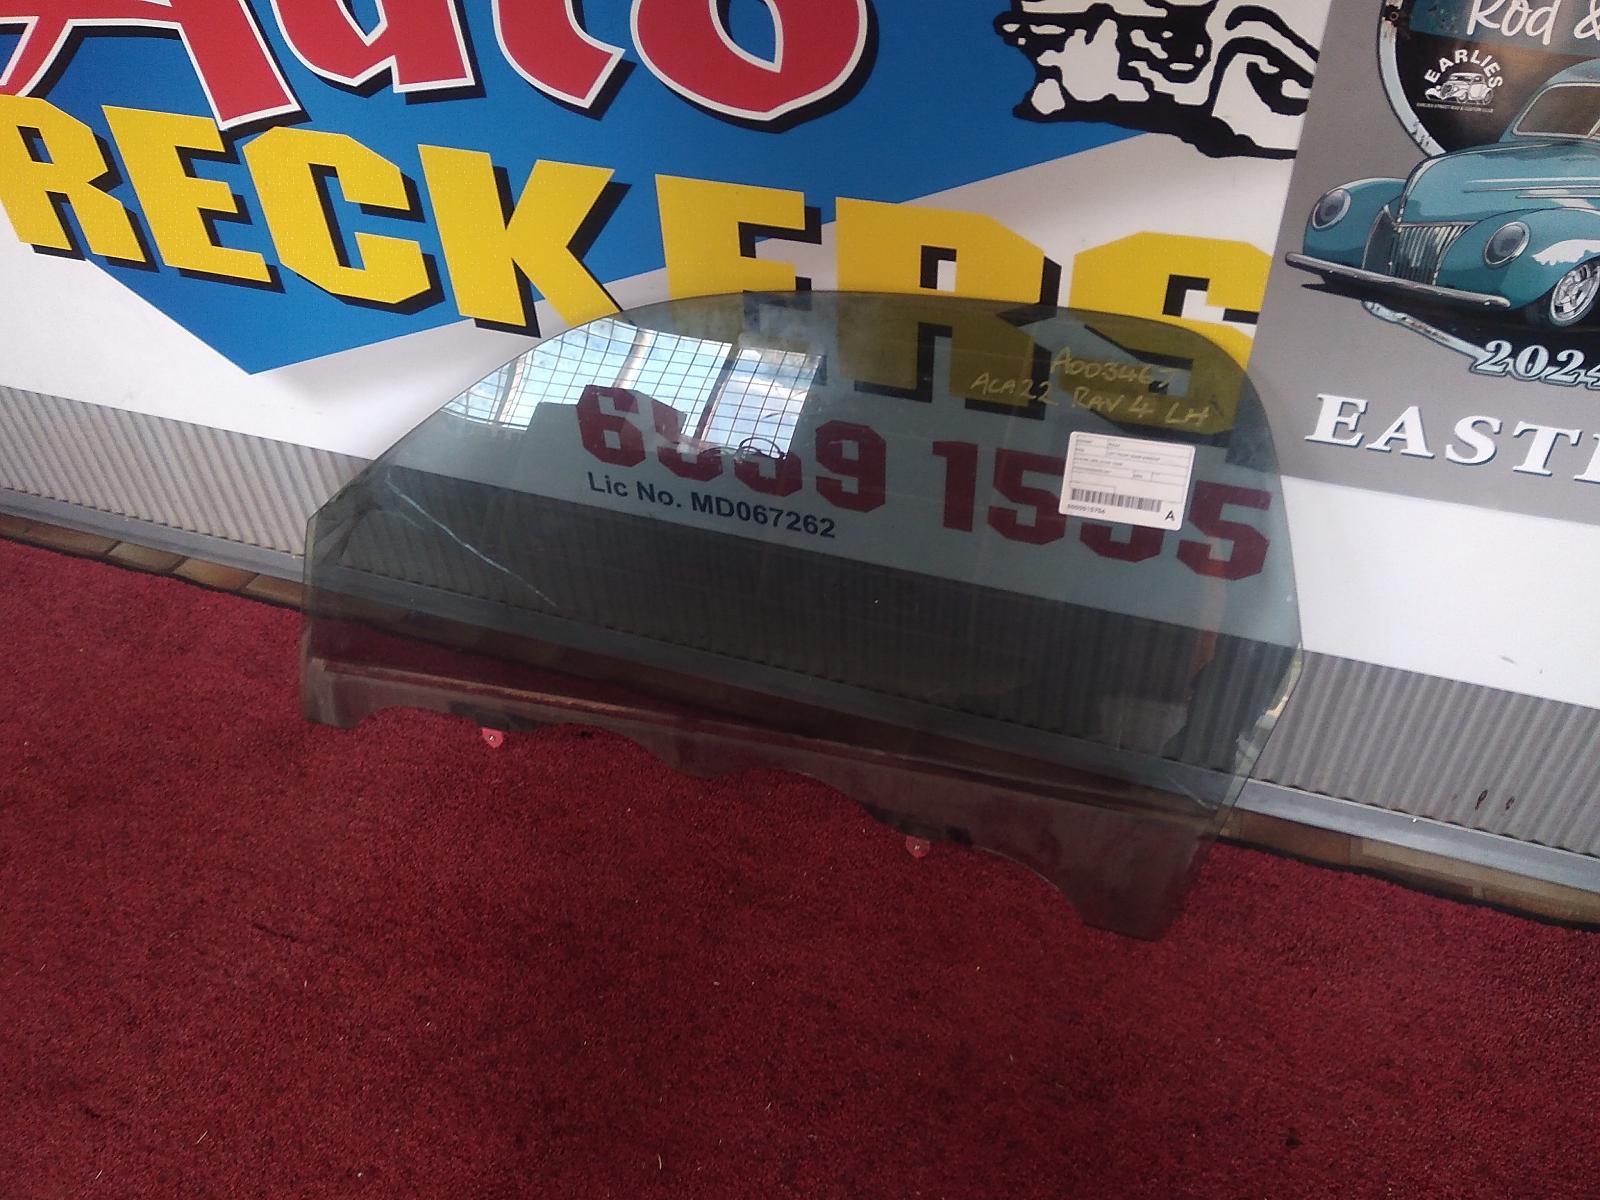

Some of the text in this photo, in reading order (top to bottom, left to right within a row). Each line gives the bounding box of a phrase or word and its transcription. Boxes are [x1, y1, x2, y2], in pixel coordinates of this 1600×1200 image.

[1424, 49, 1504, 89] EARLIES
[587, 471, 836, 539] Lic No. MD067262
[1165, 510, 1176, 522] A
